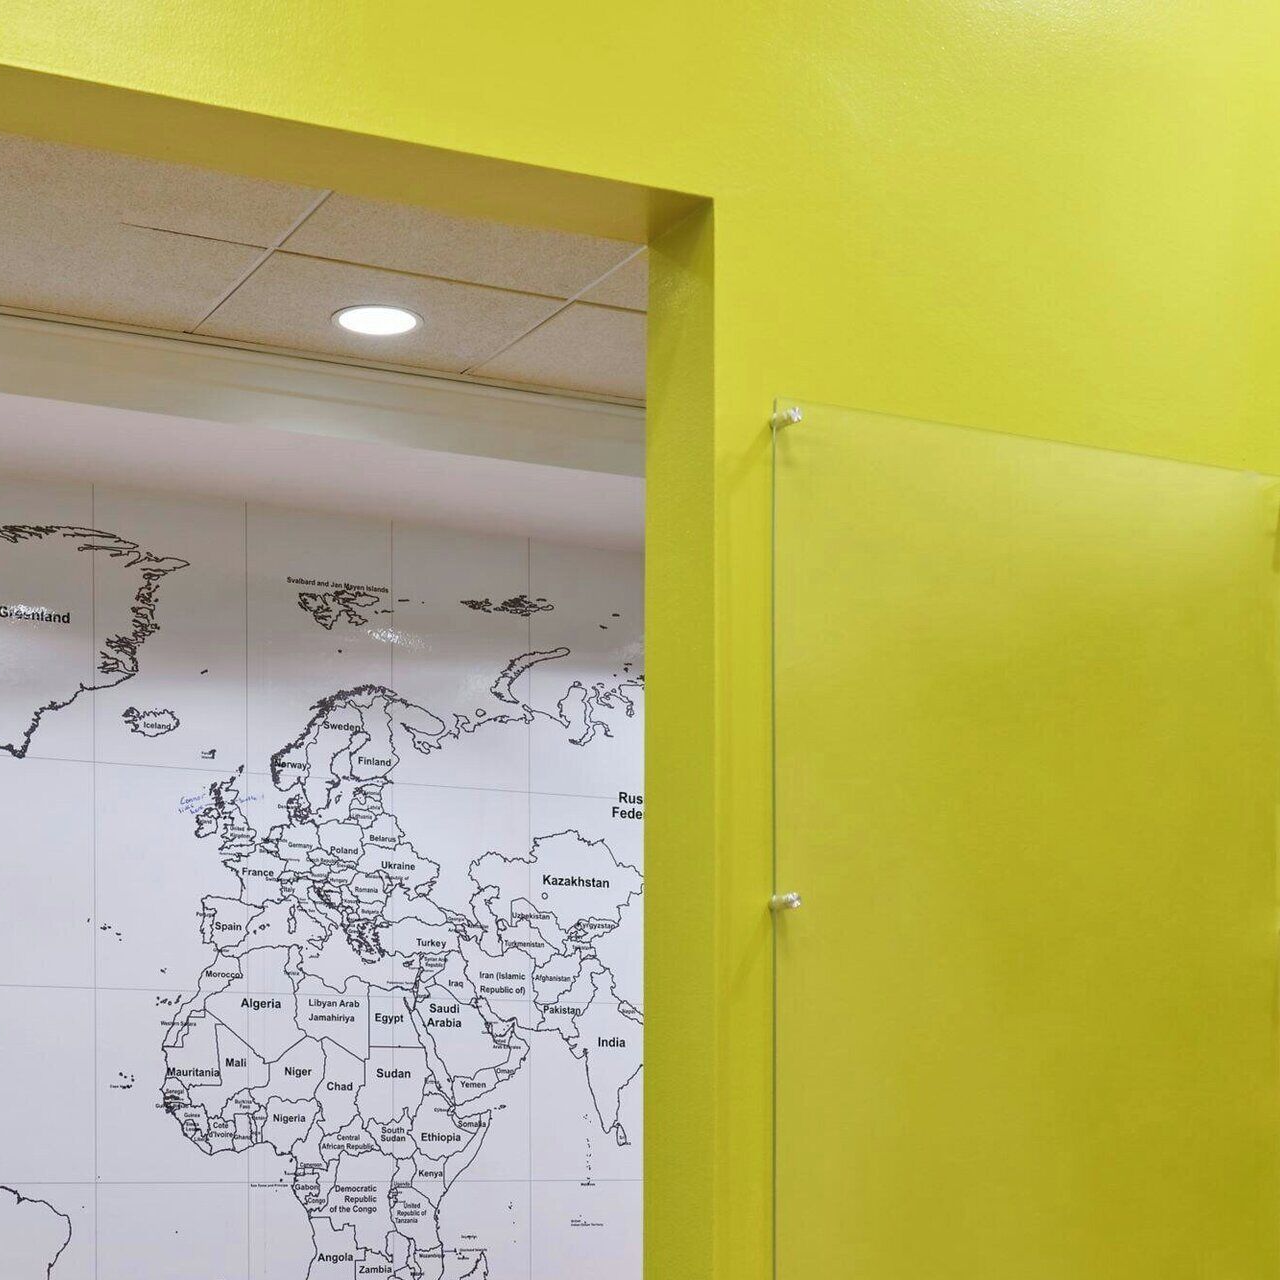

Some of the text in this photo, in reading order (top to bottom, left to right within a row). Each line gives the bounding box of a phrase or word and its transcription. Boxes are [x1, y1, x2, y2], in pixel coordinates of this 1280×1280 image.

[143, 721, 172, 731] Iceland
[324, 721, 361, 732] Sweden
[275, 760, 307, 770] Norway
[358, 757, 391, 766] Finland
[619, 792, 643, 804] Rus
[612, 807, 643, 819] Fede
[288, 842, 313, 850] Germany
[330, 846, 358, 855] Poland
[381, 861, 415, 870] Ukraine
[242, 868, 274, 877] France
[542, 875, 610, 888] Kazakhstan
[512, 912, 550, 920] Uzbekistan
[215, 922, 242, 931] Spain
[416, 938, 446, 949] Turkey
[505, 940, 545, 948] Turkmenistan
[205, 970, 241, 978] Morocco
[496, 972, 526, 981] (Islamic
[448, 980, 464, 988] Iraq
[480, 986, 526, 995] Republic of)
[241, 998, 282, 1010] Algeria
[308, 999, 360, 1009] Libyan Arab
[429, 1003, 460, 1013] Saudi
[543, 1005, 581, 1014] Pakistan
[308, 1014, 355, 1023] Jamahiriya
[375, 1013, 404, 1024] Egypt
[427, 1017, 462, 1028] Arabia
[598, 1037, 626, 1048] India
[225, 1058, 247, 1067] Mali
[167, 1067, 220, 1077] Mauritania
[284, 1067, 312, 1077] Niger
[376, 1068, 411, 1078] Sudan
[326, 1082, 353, 1091] Chad
[273, 1114, 305, 1124] Nigeria
[421, 1133, 461, 1143] Ethiopia
[346, 1143, 374, 1151] Republic
[418, 1170, 443, 1178] Kenya
[294, 1183, 319, 1191] Gabon
[345, 1195, 377, 1203] Republic
[329, 1205, 377, 1214] of the Congo
[318, 1253, 354, 1263] Angola
[359, 1266, 392, 1274] Zambia
